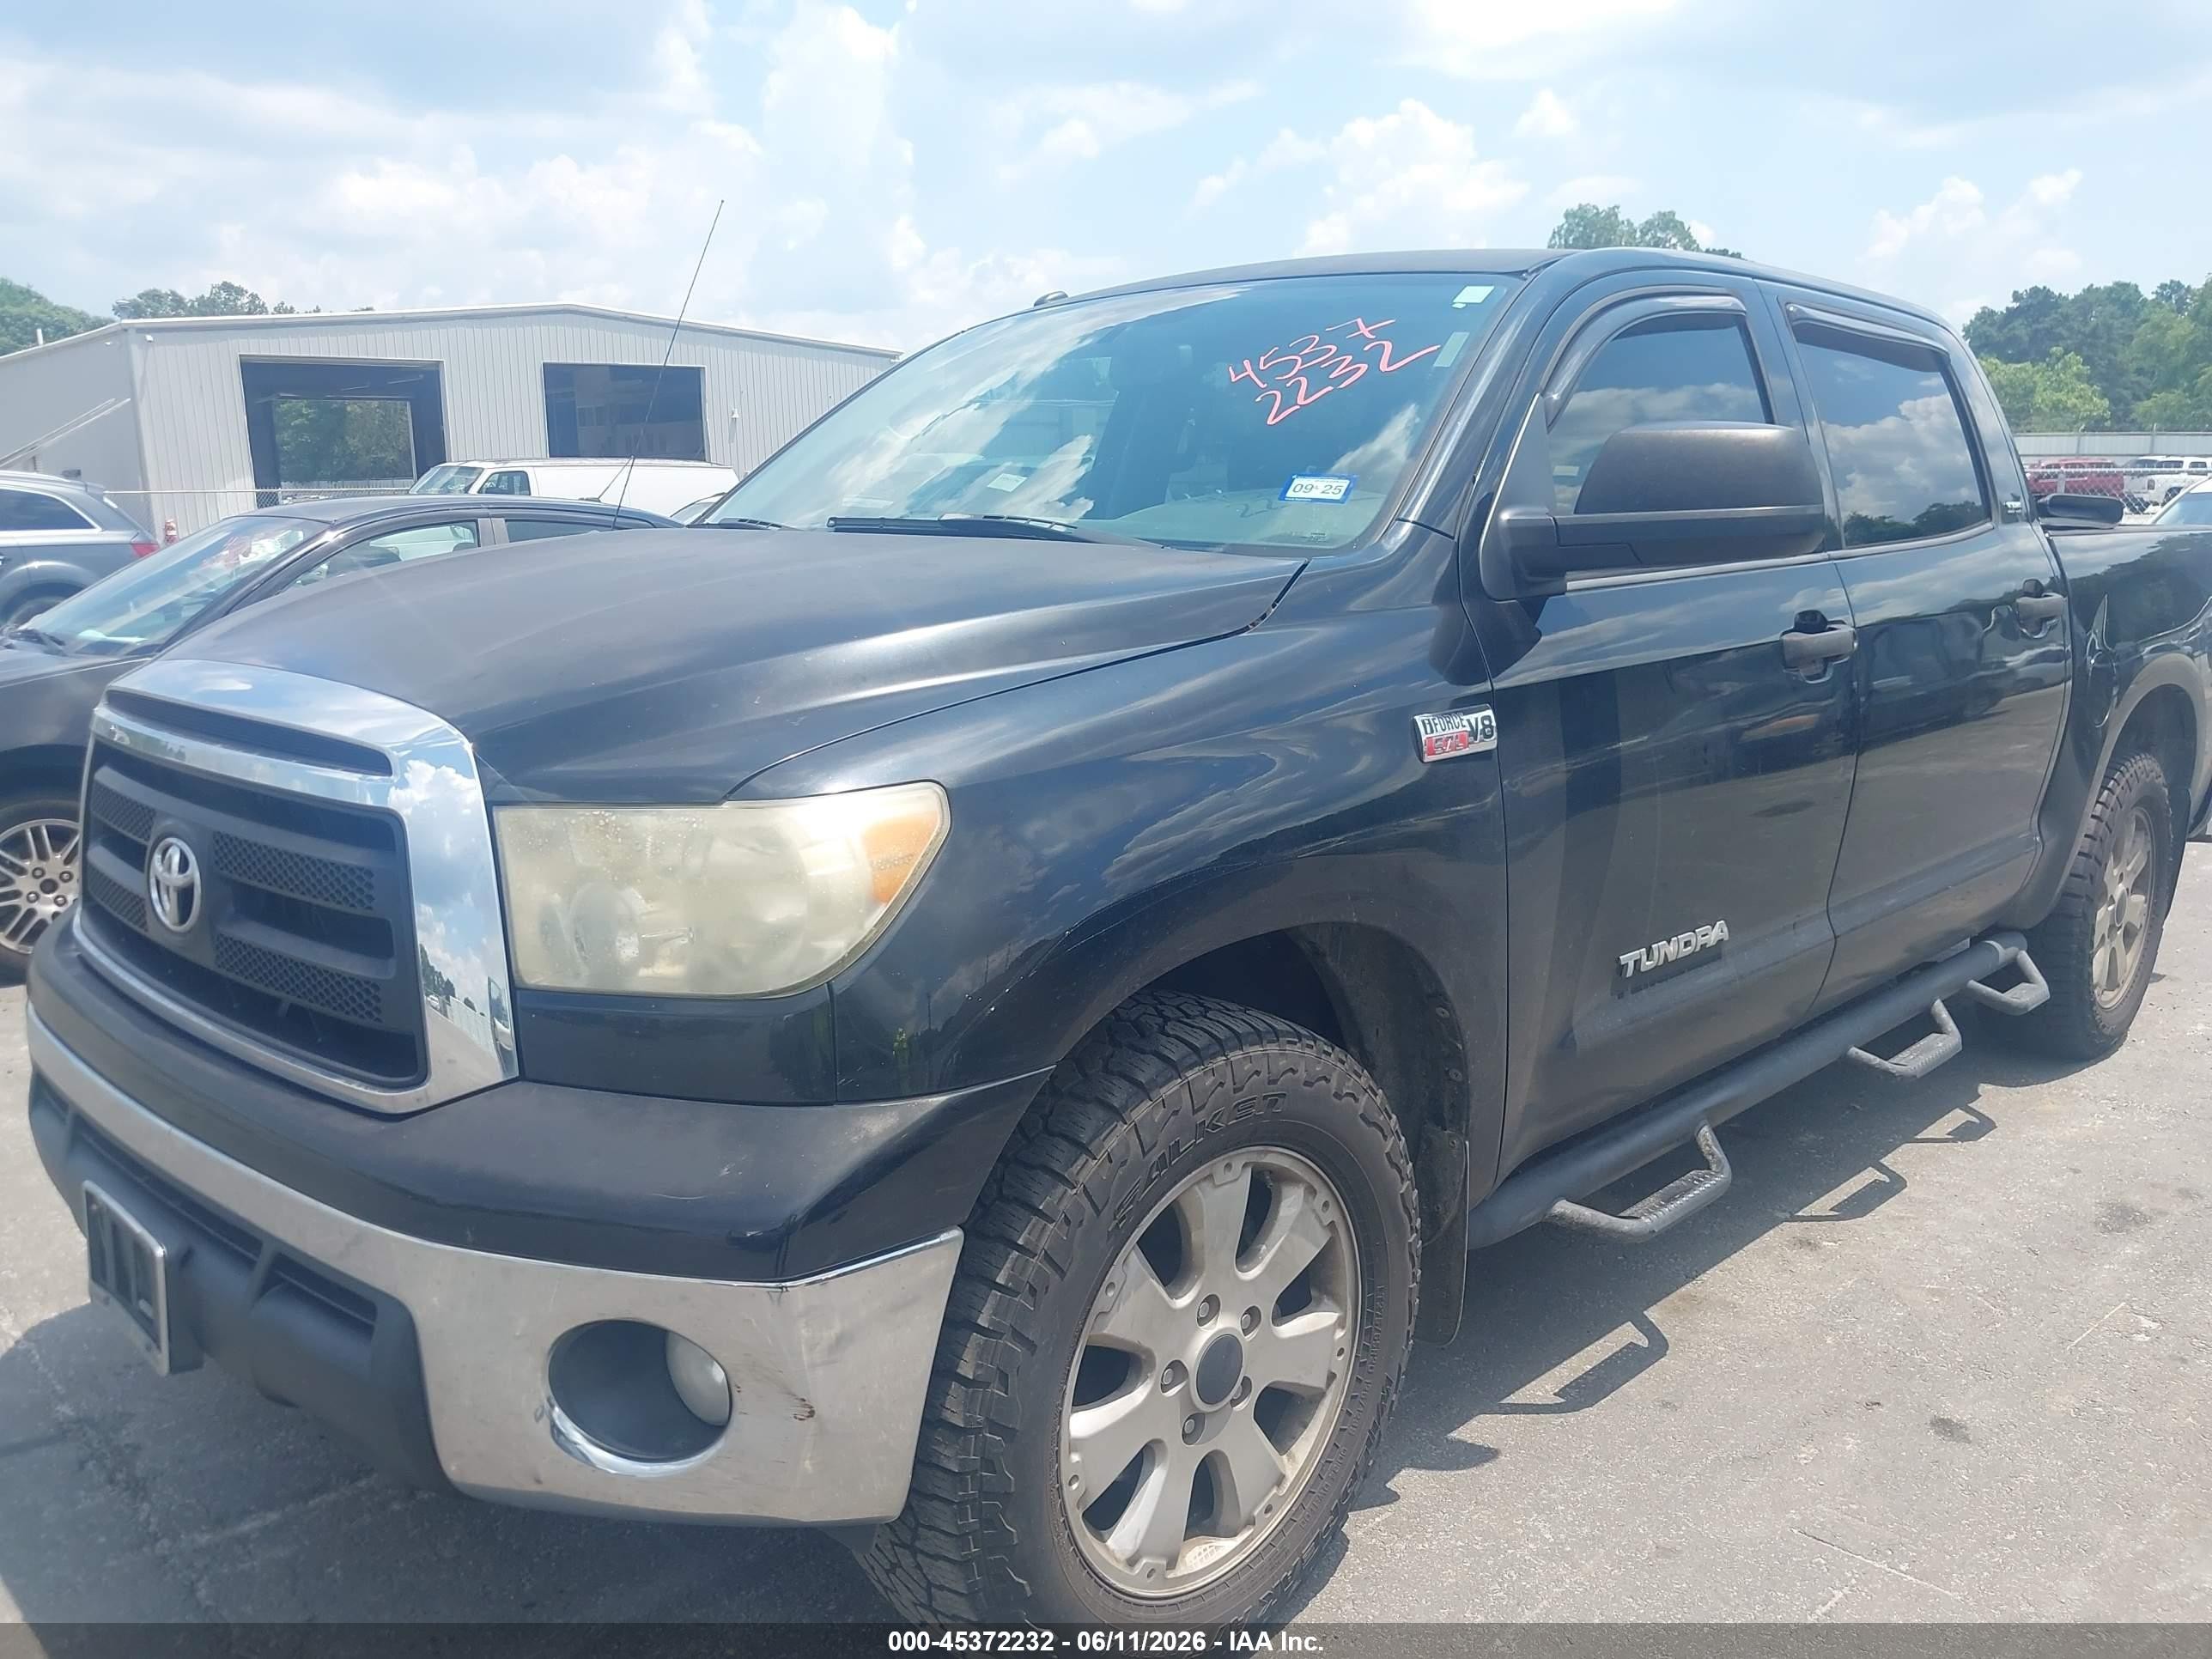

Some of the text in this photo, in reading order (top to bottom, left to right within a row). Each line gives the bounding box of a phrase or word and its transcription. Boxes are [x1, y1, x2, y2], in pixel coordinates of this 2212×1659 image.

[1229, 317, 1396, 388] 4537
[1255, 340, 1442, 425] 2232
[1291, 483, 1344, 495] 09 25
[1467, 714, 1494, 741] V8
[1619, 920, 1729, 978] TUNDRA
